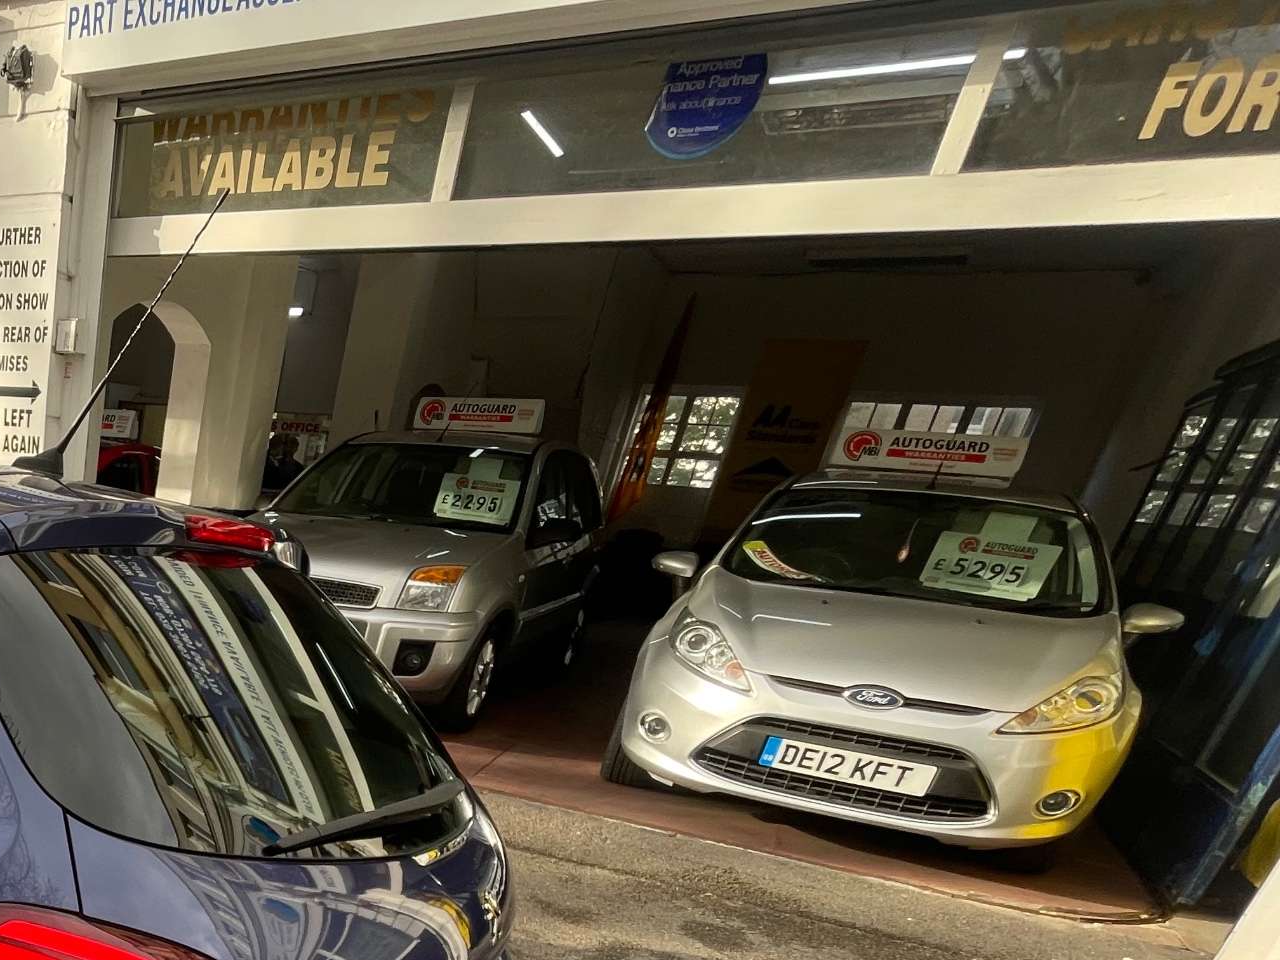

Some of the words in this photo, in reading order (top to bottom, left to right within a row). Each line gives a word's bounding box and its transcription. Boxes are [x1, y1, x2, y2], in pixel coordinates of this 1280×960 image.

[68, 0, 116, 40] PART
[709, 73, 760, 89] Partner
[1137, 52, 1280, 140] FOR
[160, 129, 397, 197] AVAILABLE
[32, 260, 47, 277] OF
[16, 293, 49, 311] SHOW
[3, 326, 31, 342] REAR
[34, 326, 48, 343] OF
[451, 403, 517, 415] AUTOGUARD
[4, 408, 32, 428] LEFT
[281, 422, 320, 433] OFFICE
[2, 434, 40, 454] AGAIN
[889, 437, 991, 454] AUTOGUARD
[856, 690, 894, 705] Ford
[778, 743, 845, 776] DE12
[849, 758, 915, 788] KFT
